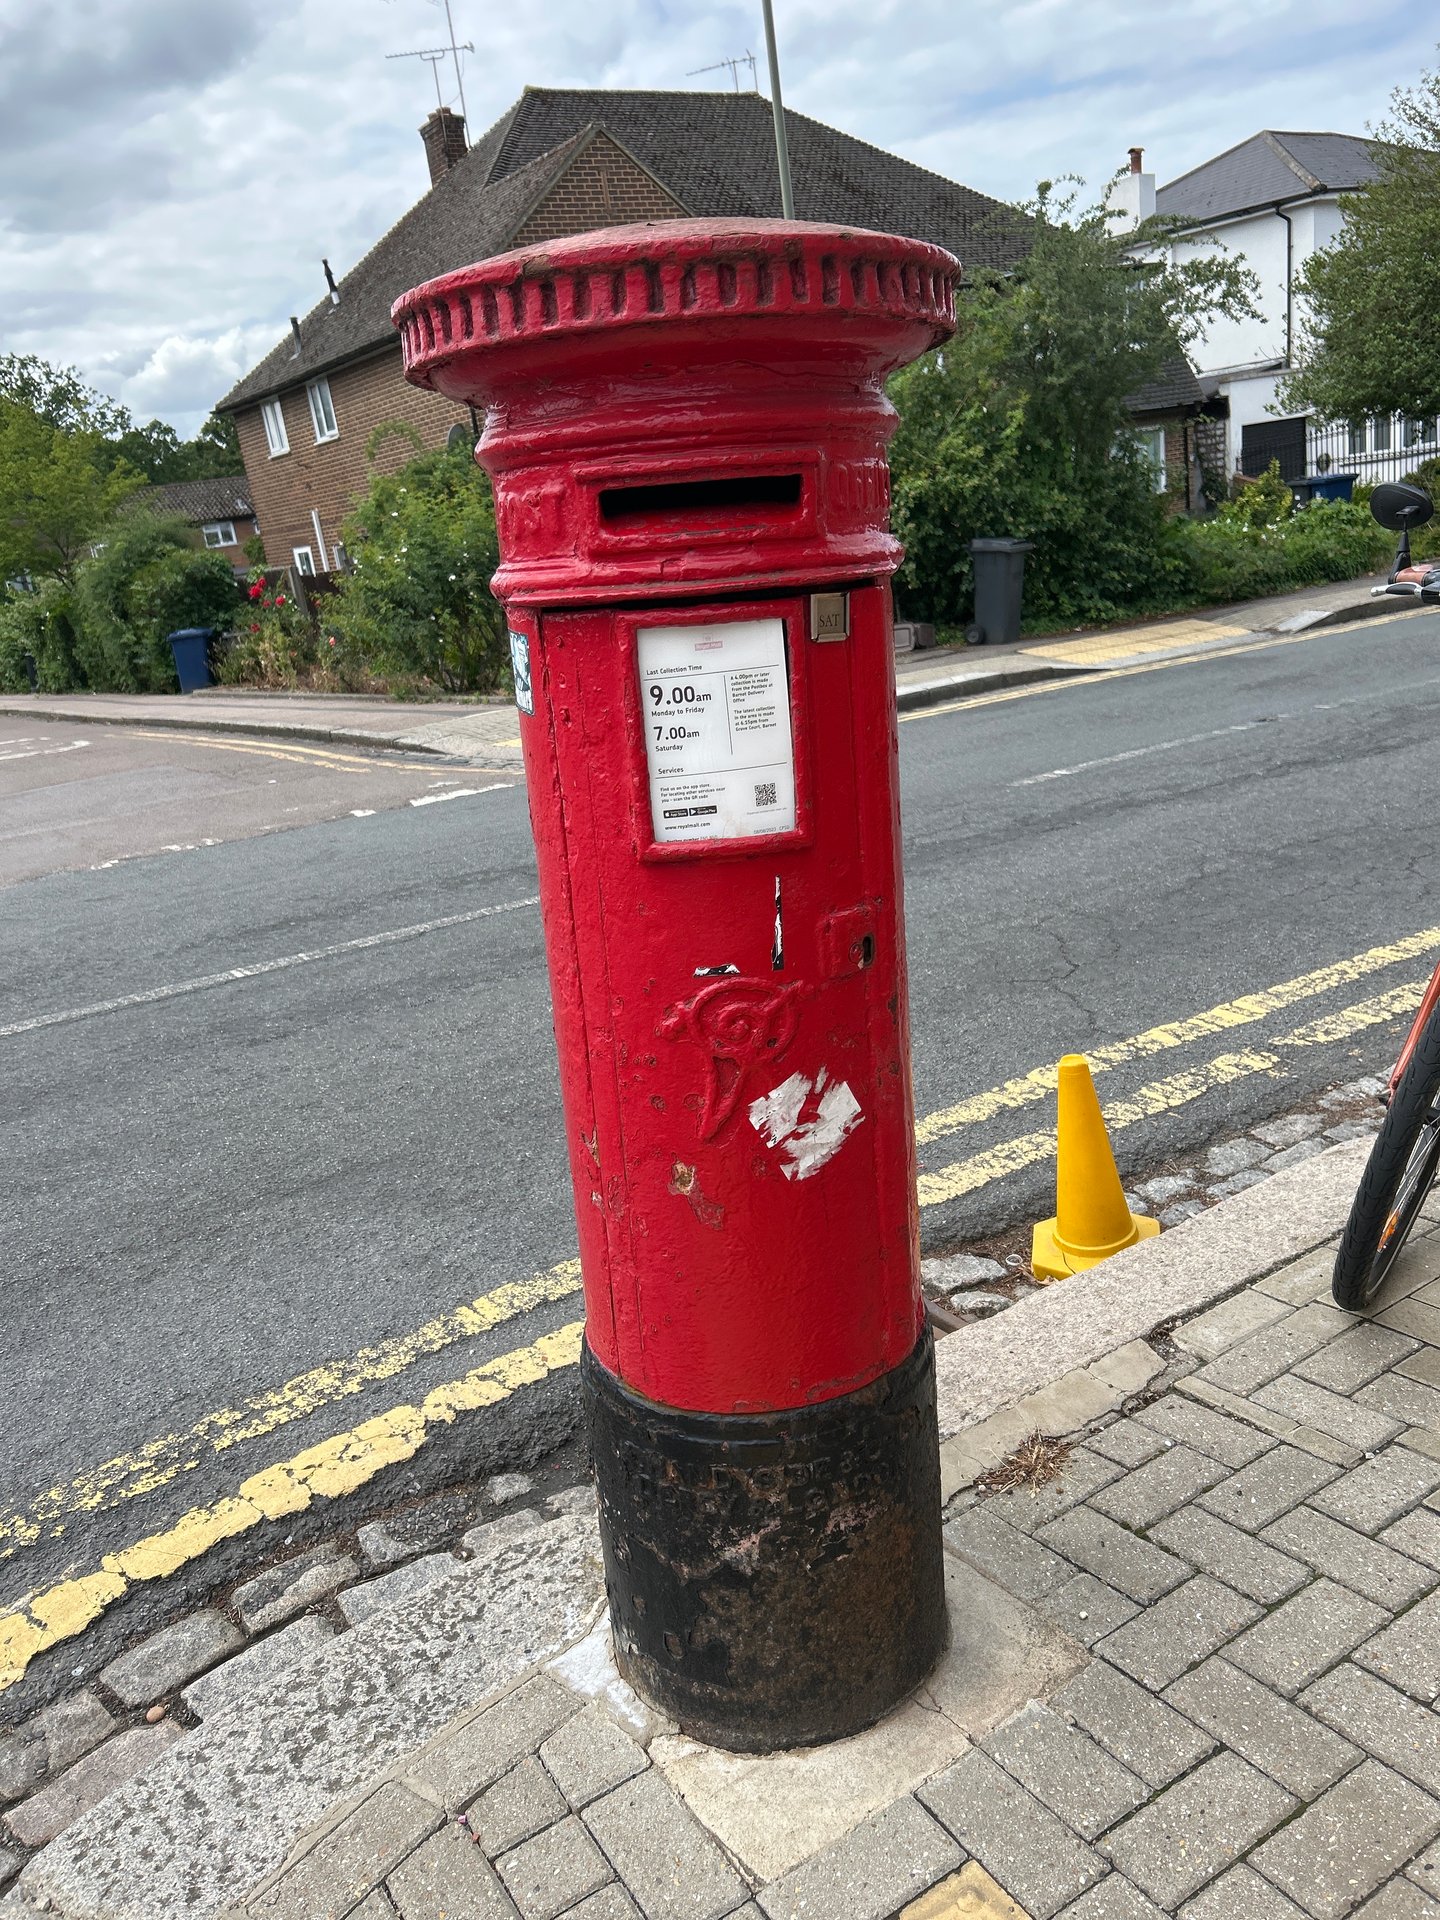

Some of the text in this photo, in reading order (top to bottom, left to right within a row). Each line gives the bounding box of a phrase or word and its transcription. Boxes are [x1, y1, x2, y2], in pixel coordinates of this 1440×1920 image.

[820, 614, 840, 627] SAT
[650, 685, 712, 706] 9.00am
[651, 709, 675, 717] Monday
[654, 726, 699, 741] 7.00am
[656, 744, 683, 752] Saturday
[665, 822, 711, 830] www.royalmail.com
